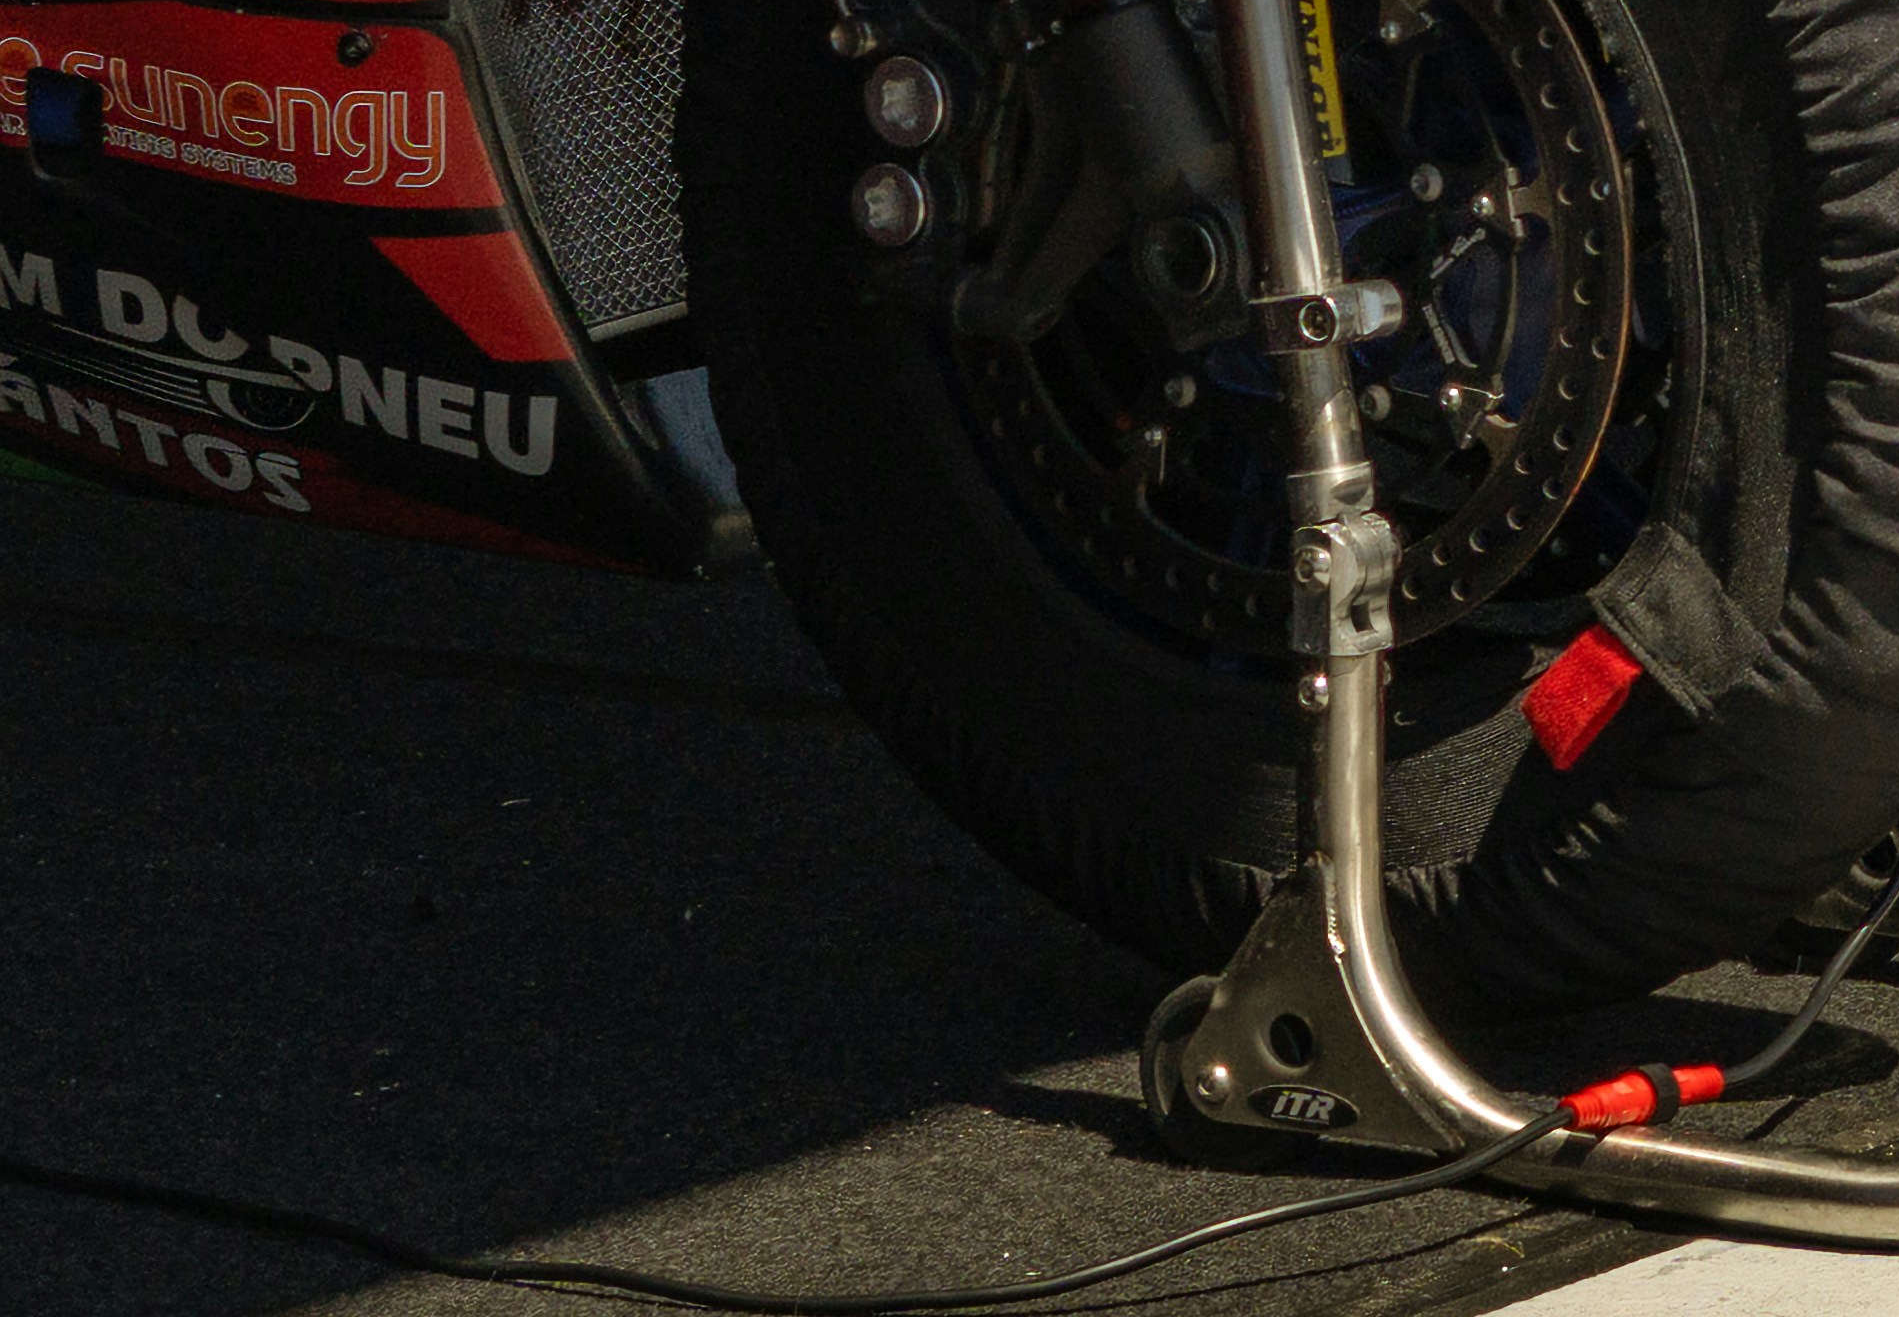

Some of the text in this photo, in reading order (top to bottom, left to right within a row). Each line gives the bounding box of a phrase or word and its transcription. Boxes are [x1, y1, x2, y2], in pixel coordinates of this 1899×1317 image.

[181, 142, 297, 186] SYSTEMS
[0, 353, 312, 513] ANTOS
[1270, 1089, 1337, 1122] ITR
